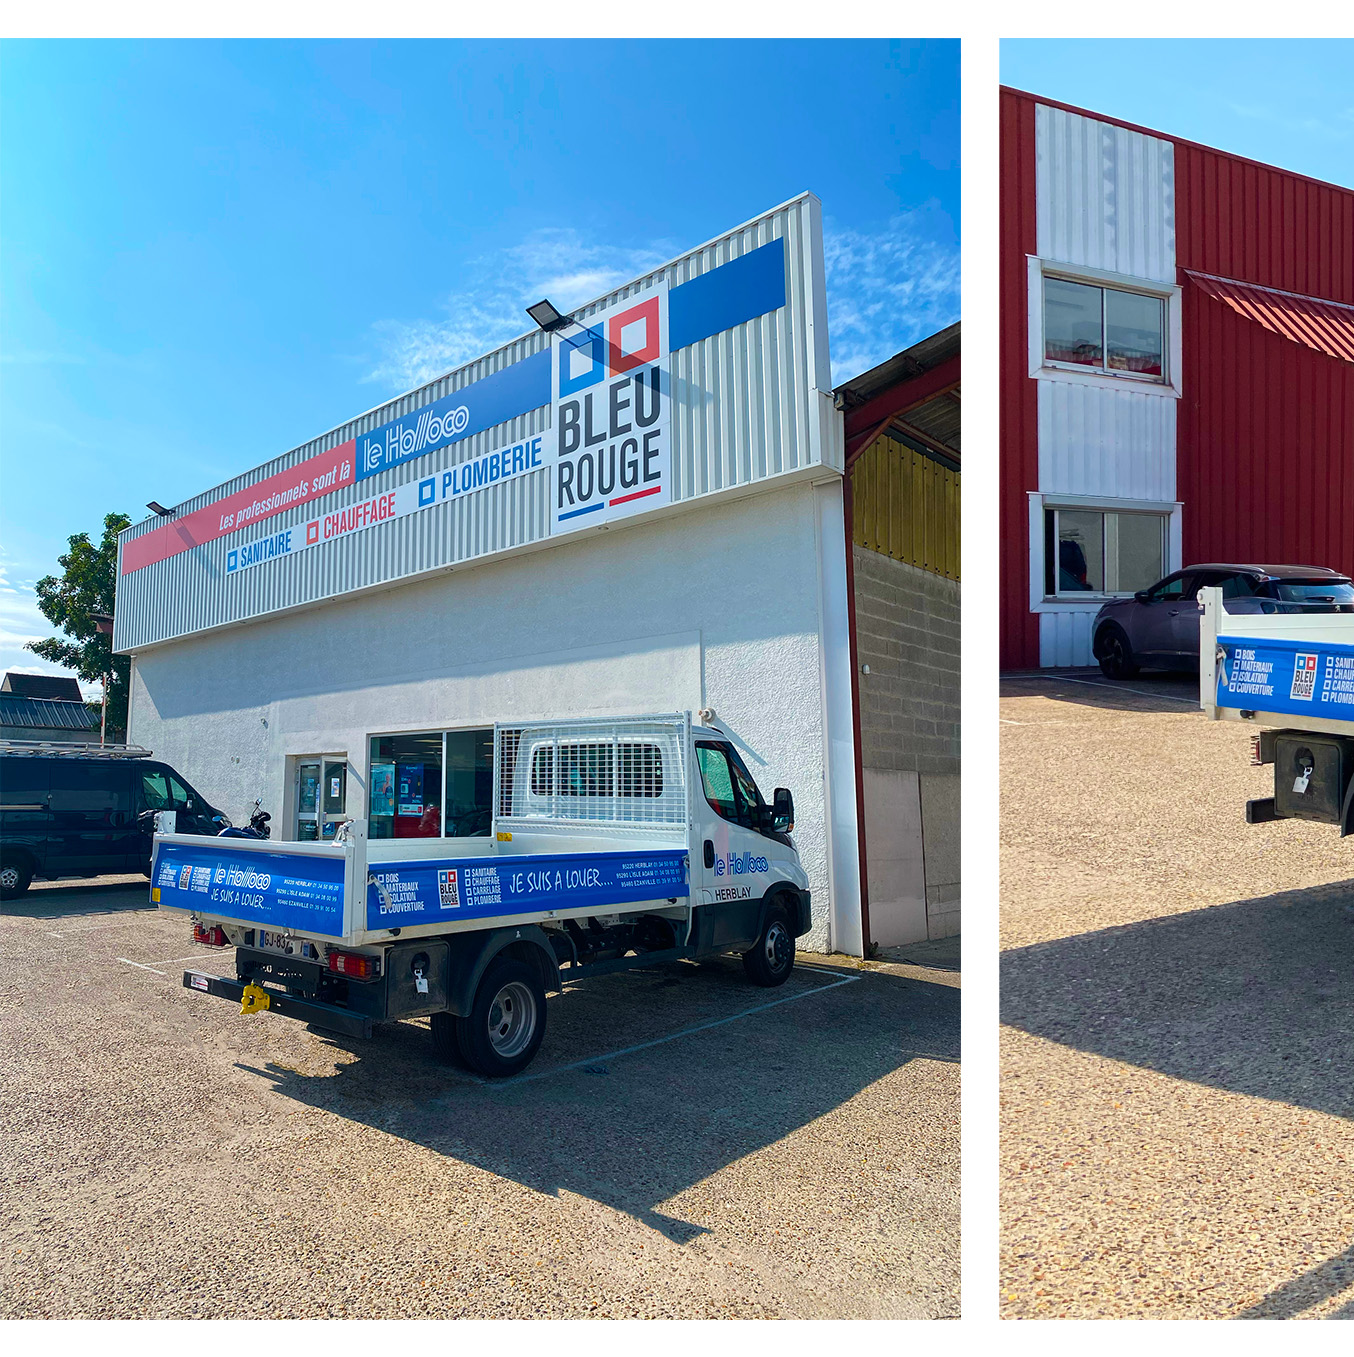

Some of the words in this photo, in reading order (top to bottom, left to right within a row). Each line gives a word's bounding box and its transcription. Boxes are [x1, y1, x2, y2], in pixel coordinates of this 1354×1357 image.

[559, 365, 660, 457] BLEU
[363, 438, 382, 472] le
[442, 436, 542, 499] PLOMBERIE
[558, 428, 661, 509] ROUGE
[220, 514, 234, 531] Les
[236, 480, 309, 529] professionnels
[312, 468, 336, 493] sont
[340, 460, 351, 482] là
[324, 492, 396, 539] CHAUFFAGE
[240, 530, 292, 566] SANITAIRE
[1242, 650, 1256, 660] BOIS
[1240, 660, 1274, 674] MATERIAUX
[1238, 672, 1268, 684] ISOLATION
[1294, 670, 1315, 683] BLEU
[1236, 683, 1274, 696] COUVERTURE
[1292, 682, 1312, 695] ROUGE
[714, 852, 726, 876] le
[213, 862, 226, 884] le
[385, 873, 400, 883] BOIS
[471, 867, 497, 877] SANITAIRE
[295, 880, 312, 888] HERBLAY
[472, 876, 500, 886] CHAUFFAGE
[510, 872, 525, 894] JE
[528, 870, 552, 892] SUIS
[554, 870, 563, 891] A
[440, 883, 457, 895] BLEU
[472, 884, 502, 896] CARRELAGE
[714, 886, 752, 900] HERBLAY
[211, 888, 219, 901] JE
[220, 889, 234, 904] SUIS
[234, 891, 240, 905] A
[474, 894, 502, 905] PLOMBERIE
